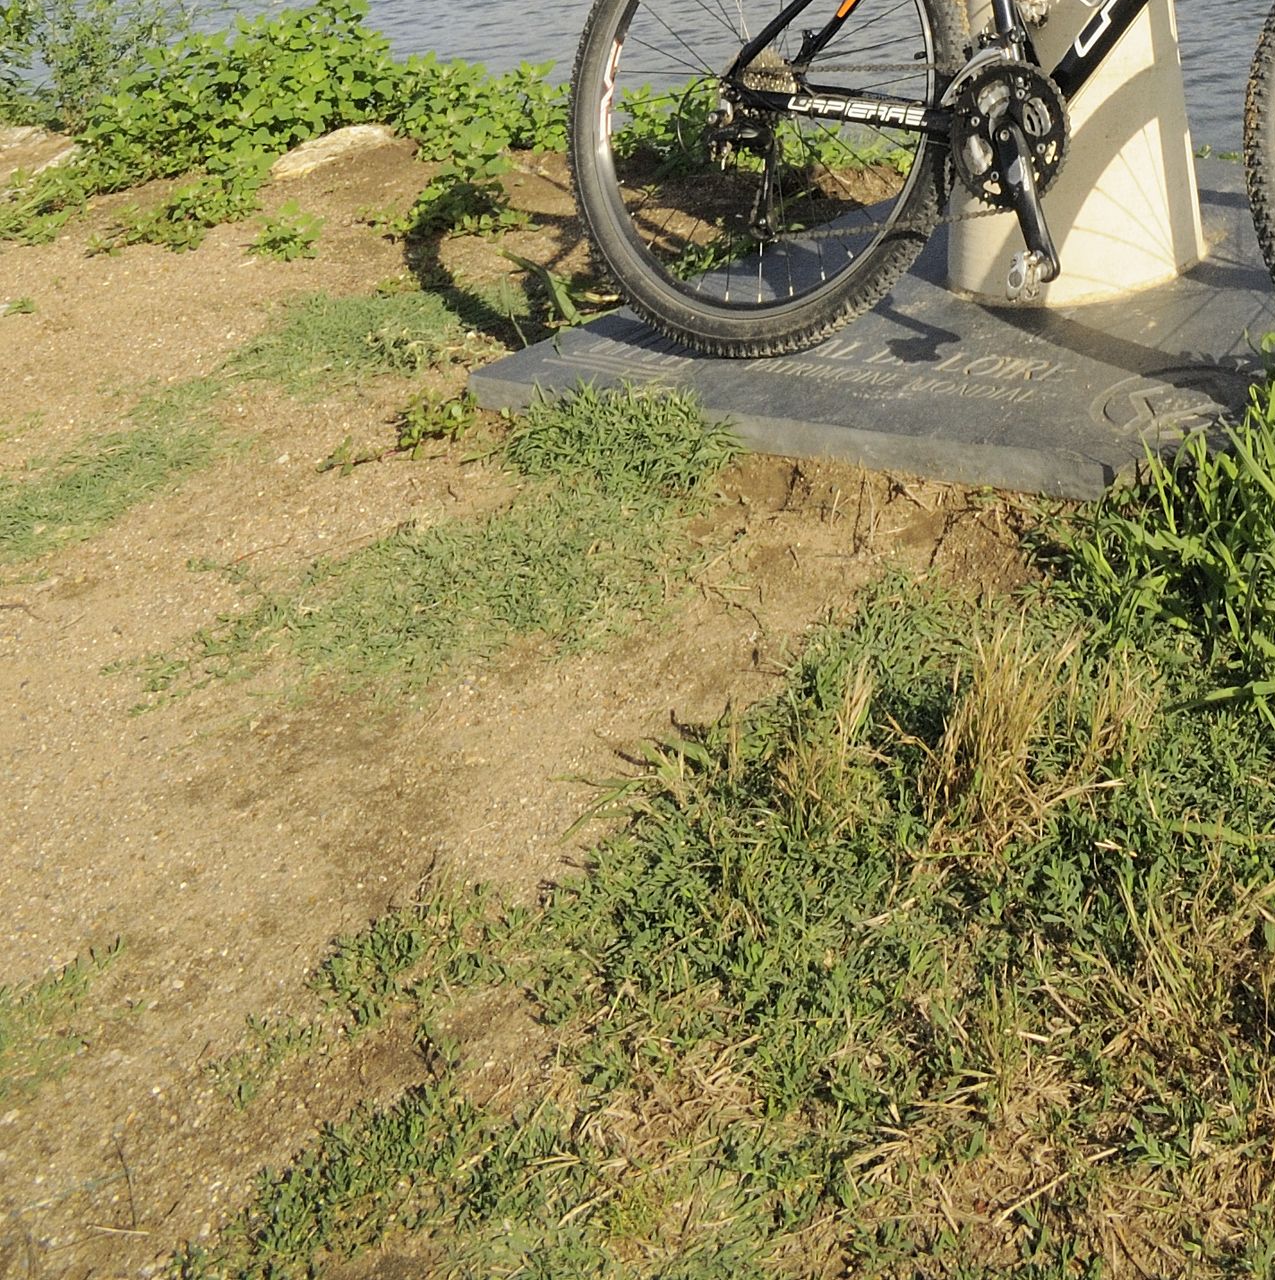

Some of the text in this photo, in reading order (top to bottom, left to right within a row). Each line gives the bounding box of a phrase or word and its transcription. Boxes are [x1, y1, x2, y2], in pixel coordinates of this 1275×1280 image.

[787, 96, 928, 127] LAPIERRE
[744, 358, 1039, 403] PATRIMOINE MONDIAL
[800, 339, 863, 360] AL
[930, 351, 1077, 382] LOIRE
